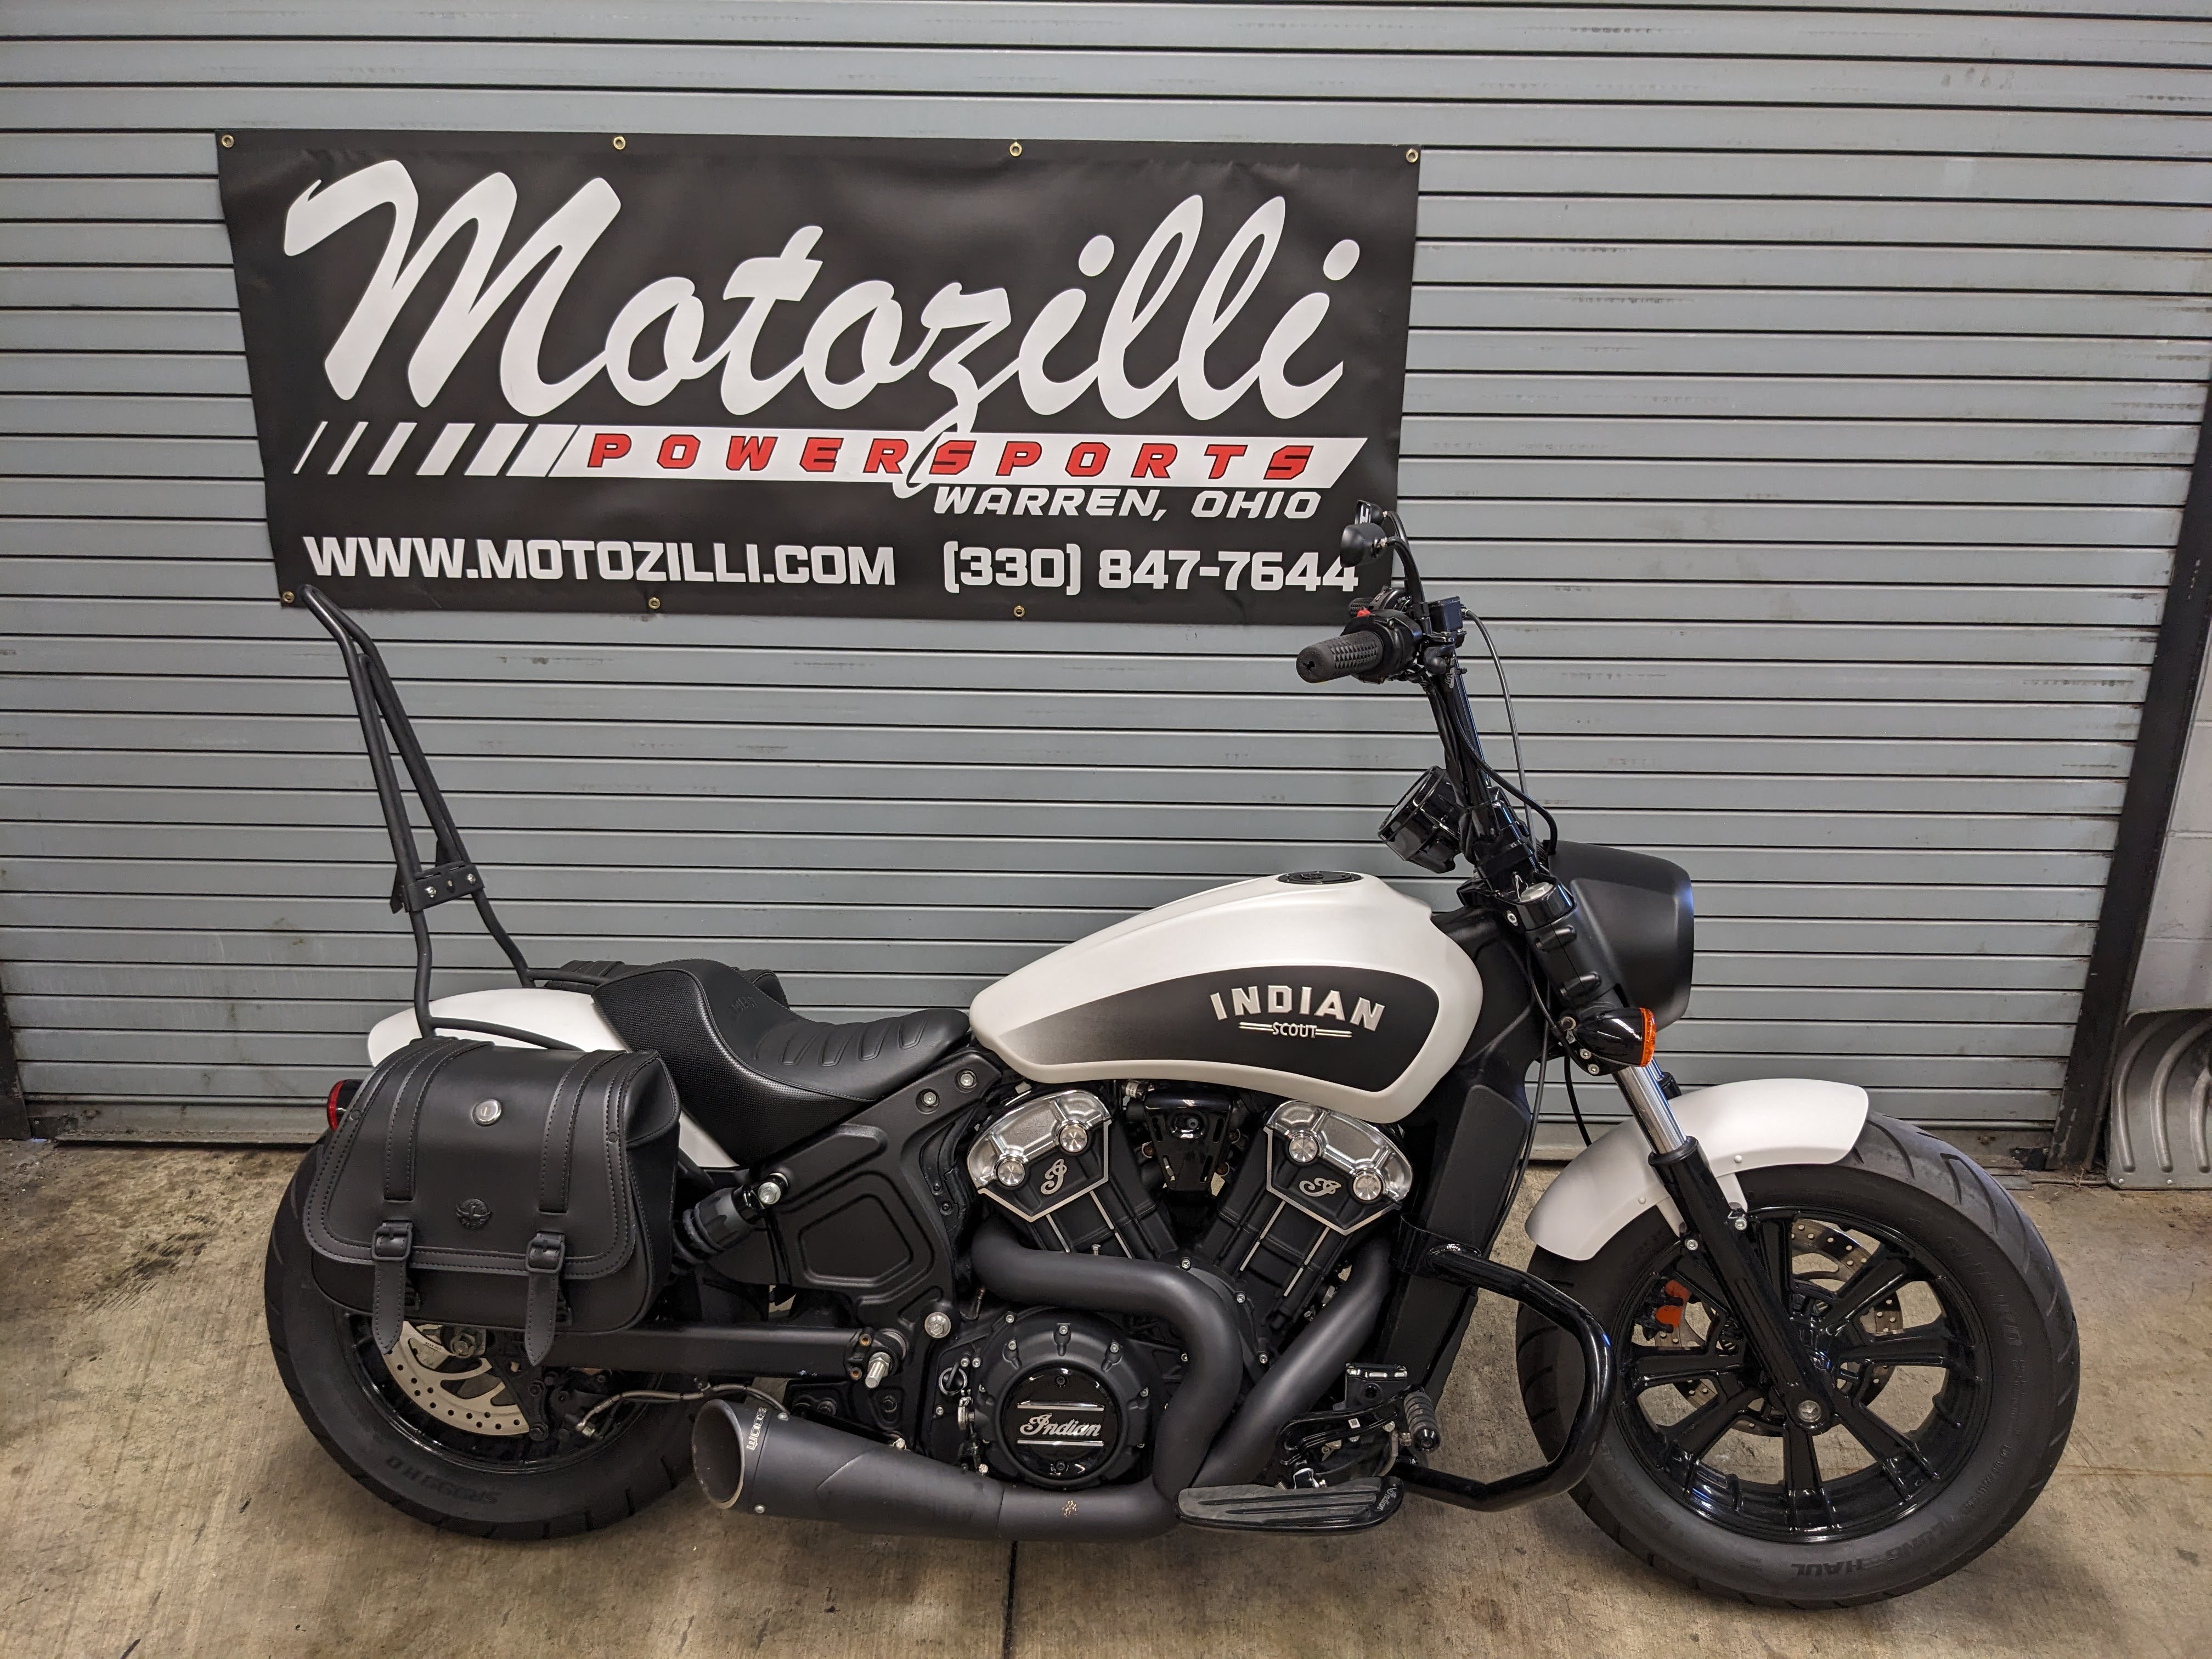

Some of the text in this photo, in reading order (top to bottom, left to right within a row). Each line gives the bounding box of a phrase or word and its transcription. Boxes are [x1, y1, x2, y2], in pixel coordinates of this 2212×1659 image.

[284, 160, 1361, 499] Motozilli
[586, 433, 1314, 479] POWERSPORTS
[933, 486, 1322, 521] WARREN, OHIO
[303, 535, 1359, 596] WWW.MOTOZILLI.COM (330) 847-7644
[1210, 985, 1385, 1031] INDIAN
[1272, 1022, 1317, 1039] SCOUT
[1019, 1413, 1101, 1437] Indian
